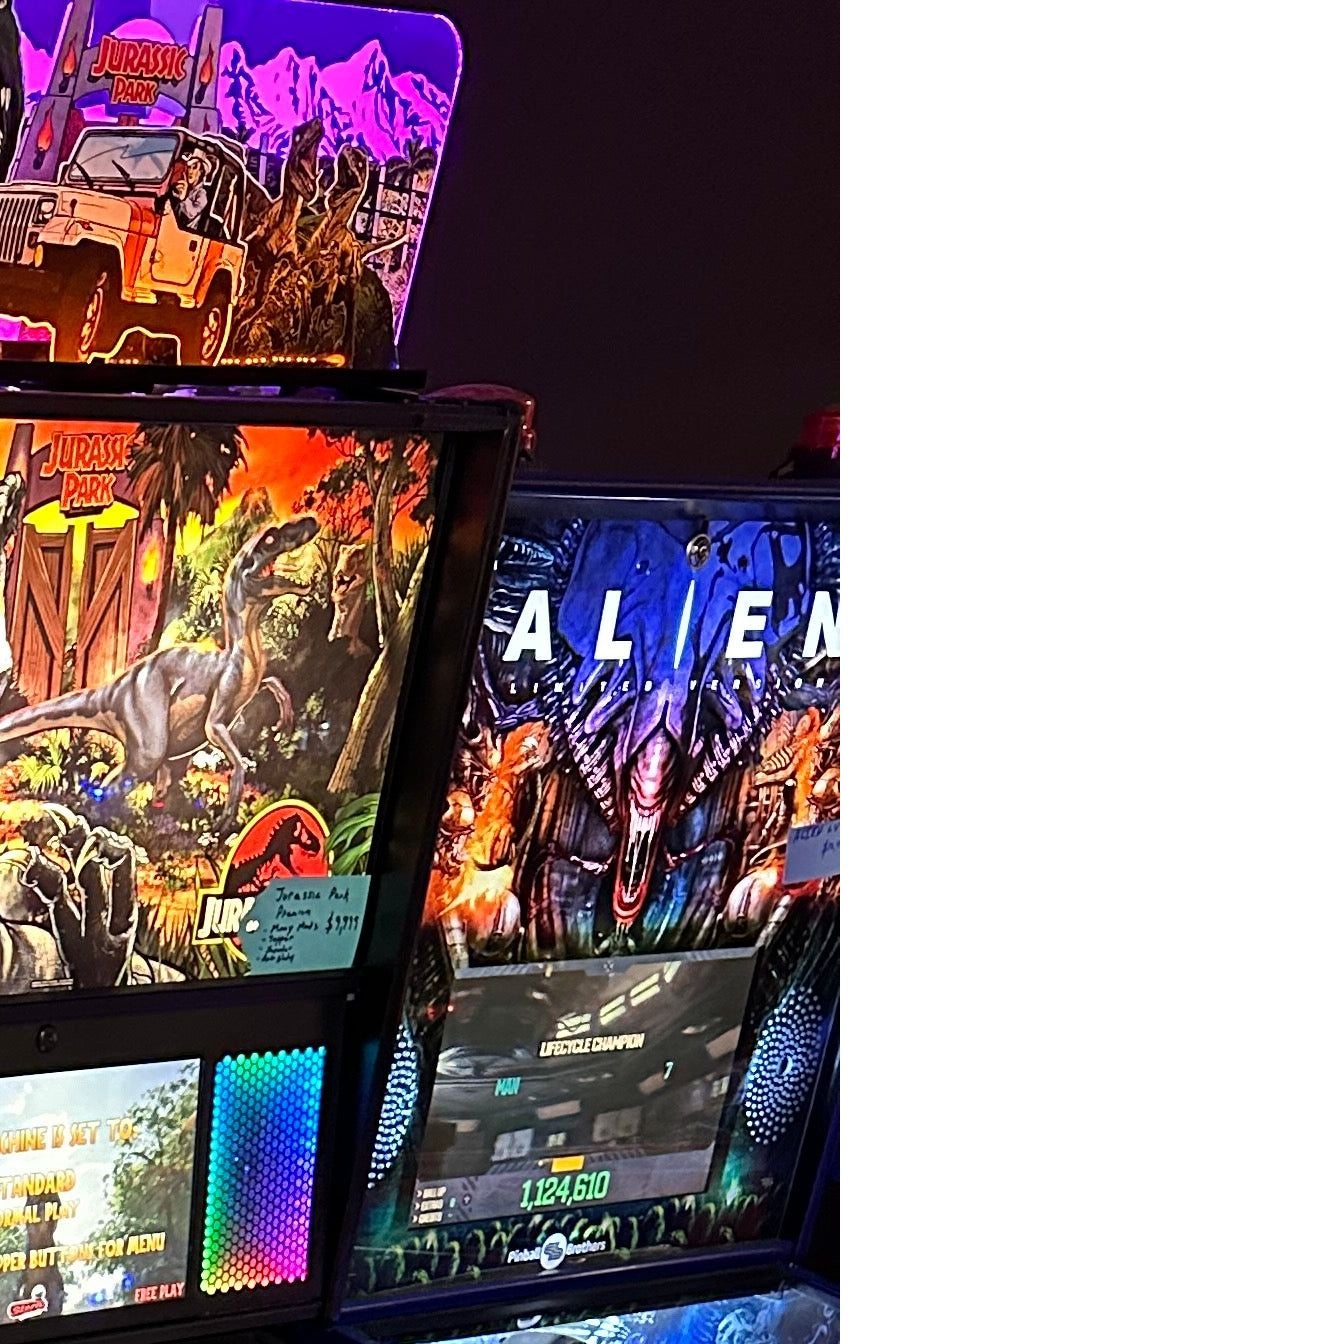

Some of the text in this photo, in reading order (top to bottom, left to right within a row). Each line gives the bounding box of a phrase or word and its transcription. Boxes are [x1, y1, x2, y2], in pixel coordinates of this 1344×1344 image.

[91, 35, 189, 81] JURASSIC
[111, 76, 157, 104] PARK
[62, 472, 115, 507] PARK
[502, 578, 840, 670] ALIEN
[689, 676, 826, 692] VERSION
[539, 1032, 646, 1058] LIFECYCLE CHAMPION
[495, 1076, 521, 1097] MAN
[51, 1123, 65, 1148] IS
[69, 1122, 101, 1147] SET
[520, 1171, 610, 1211] 1,124,610
[44, 1199, 80, 1223] PLAY
[97, 1239, 125, 1258] FOR
[126, 1231, 166, 1254] MENU
[507, 1246, 541, 1264] Pinball
[134, 1282, 185, 1303] FREE PLAY
